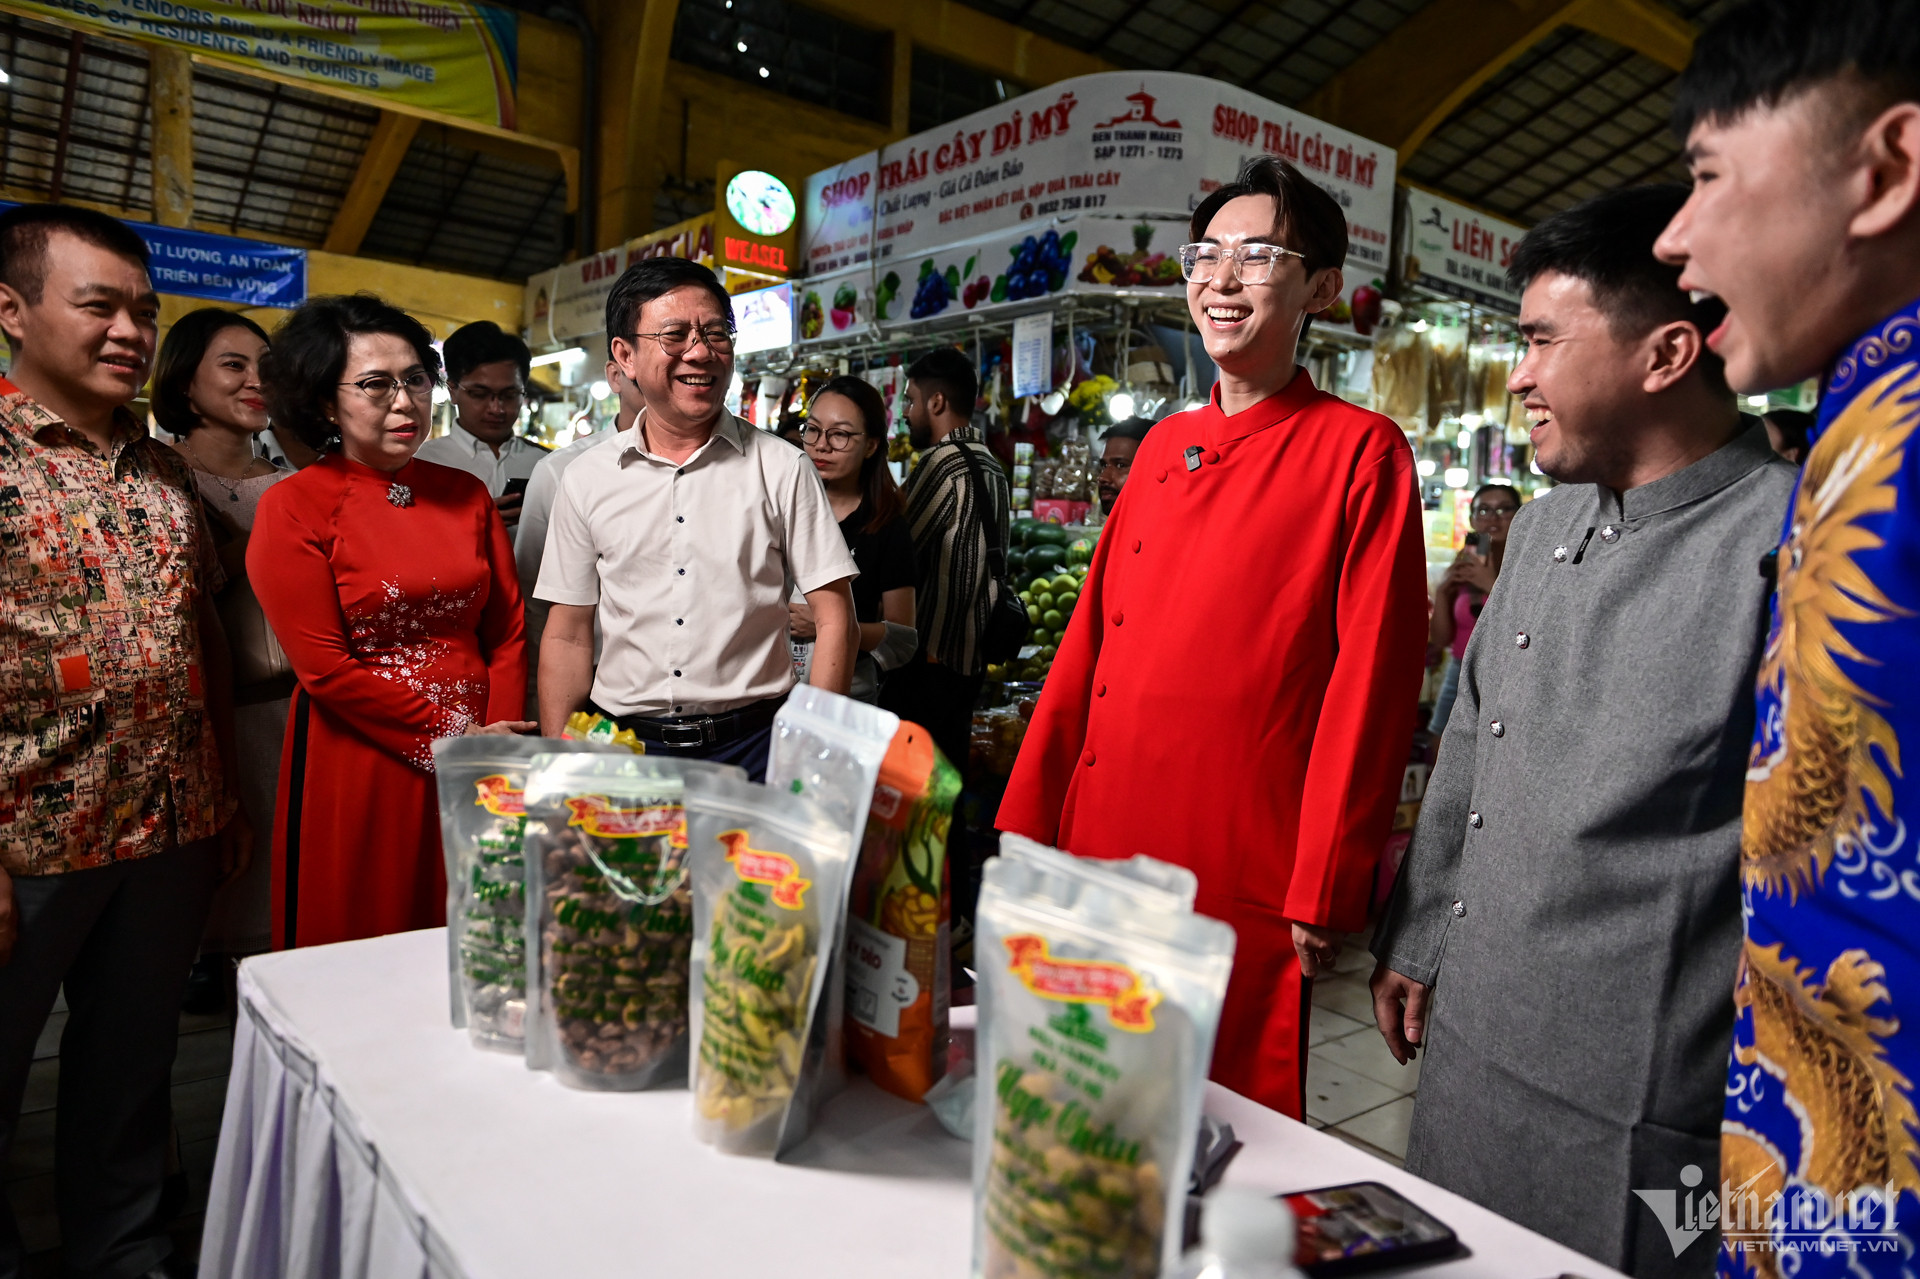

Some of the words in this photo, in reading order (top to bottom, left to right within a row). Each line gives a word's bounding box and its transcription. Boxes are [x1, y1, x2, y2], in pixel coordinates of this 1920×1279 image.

[121, 0, 214, 27] VENDORS
[220, 16, 275, 41] BUILD
[279, 31, 293, 46] A
[297, 34, 379, 68] FRIENDLY
[384, 56, 435, 83] IMAGE
[139, 19, 250, 57] RESIDENTS
[254, 45, 291, 66] AND
[297, 55, 379, 89] TOURISTS
[820, 171, 871, 208] SHOP
[878, 147, 928, 192] TRÁI
[933, 129, 987, 175] CÂY
[1028, 91, 1078, 144] MỸ
[1120, 145, 1145, 158] 1271
[1158, 146, 1183, 161] 1273
[1213, 103, 1260, 146] SHOP
[1261, 121, 1301, 163] TRÁI
[1303, 132, 1335, 174] CÂY
[1354, 152, 1378, 189] MỸ
[1097, 169, 1121, 187] CÂY
[229, 254, 249, 269] AN
[725, 236, 788, 271] WEASEL
[1453, 217, 1495, 263] LIÊN
